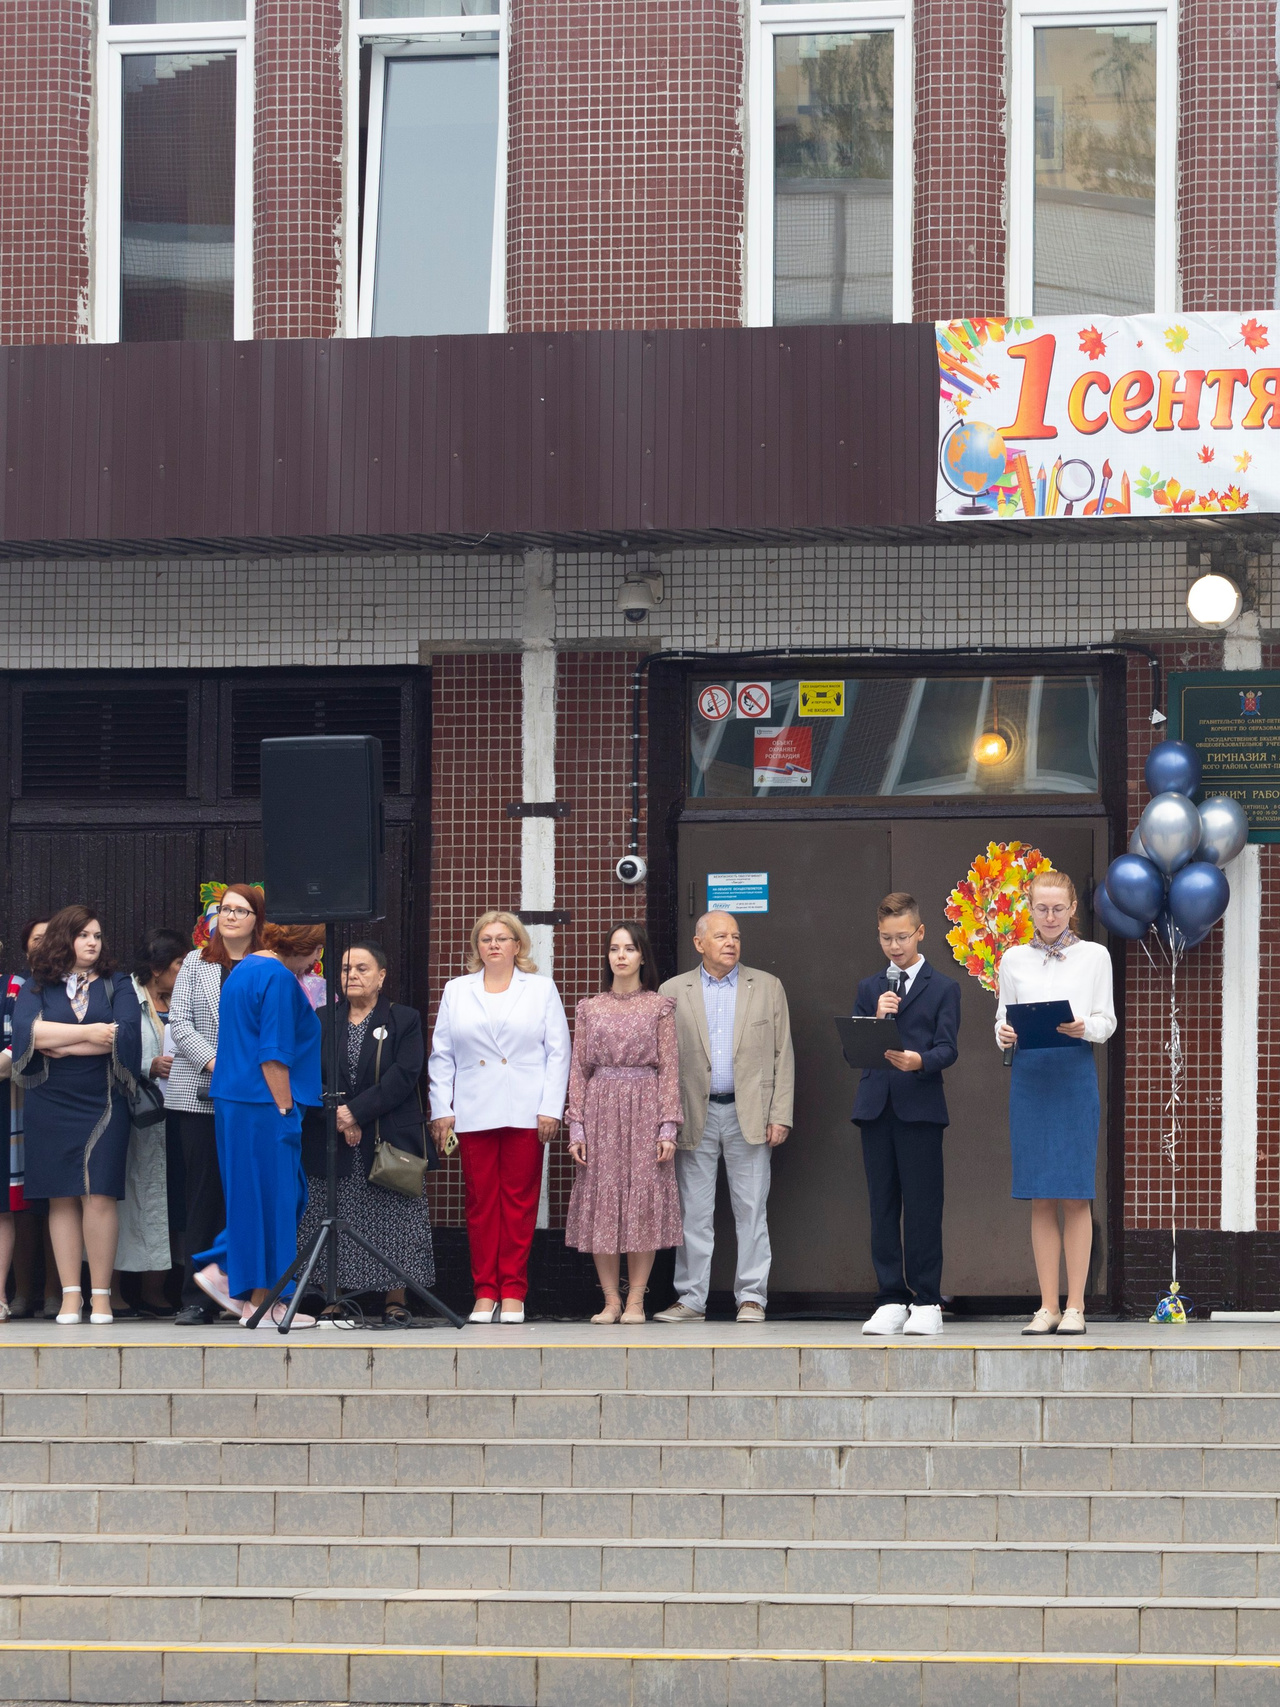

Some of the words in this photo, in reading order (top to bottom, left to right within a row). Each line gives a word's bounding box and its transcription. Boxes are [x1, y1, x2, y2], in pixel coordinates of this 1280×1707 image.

[996, 333, 1058, 440] 1
[1207, 752, 1267, 762] ГИМНАЗИЯ
[1204, 790, 1247, 799] РЕЖИМ
